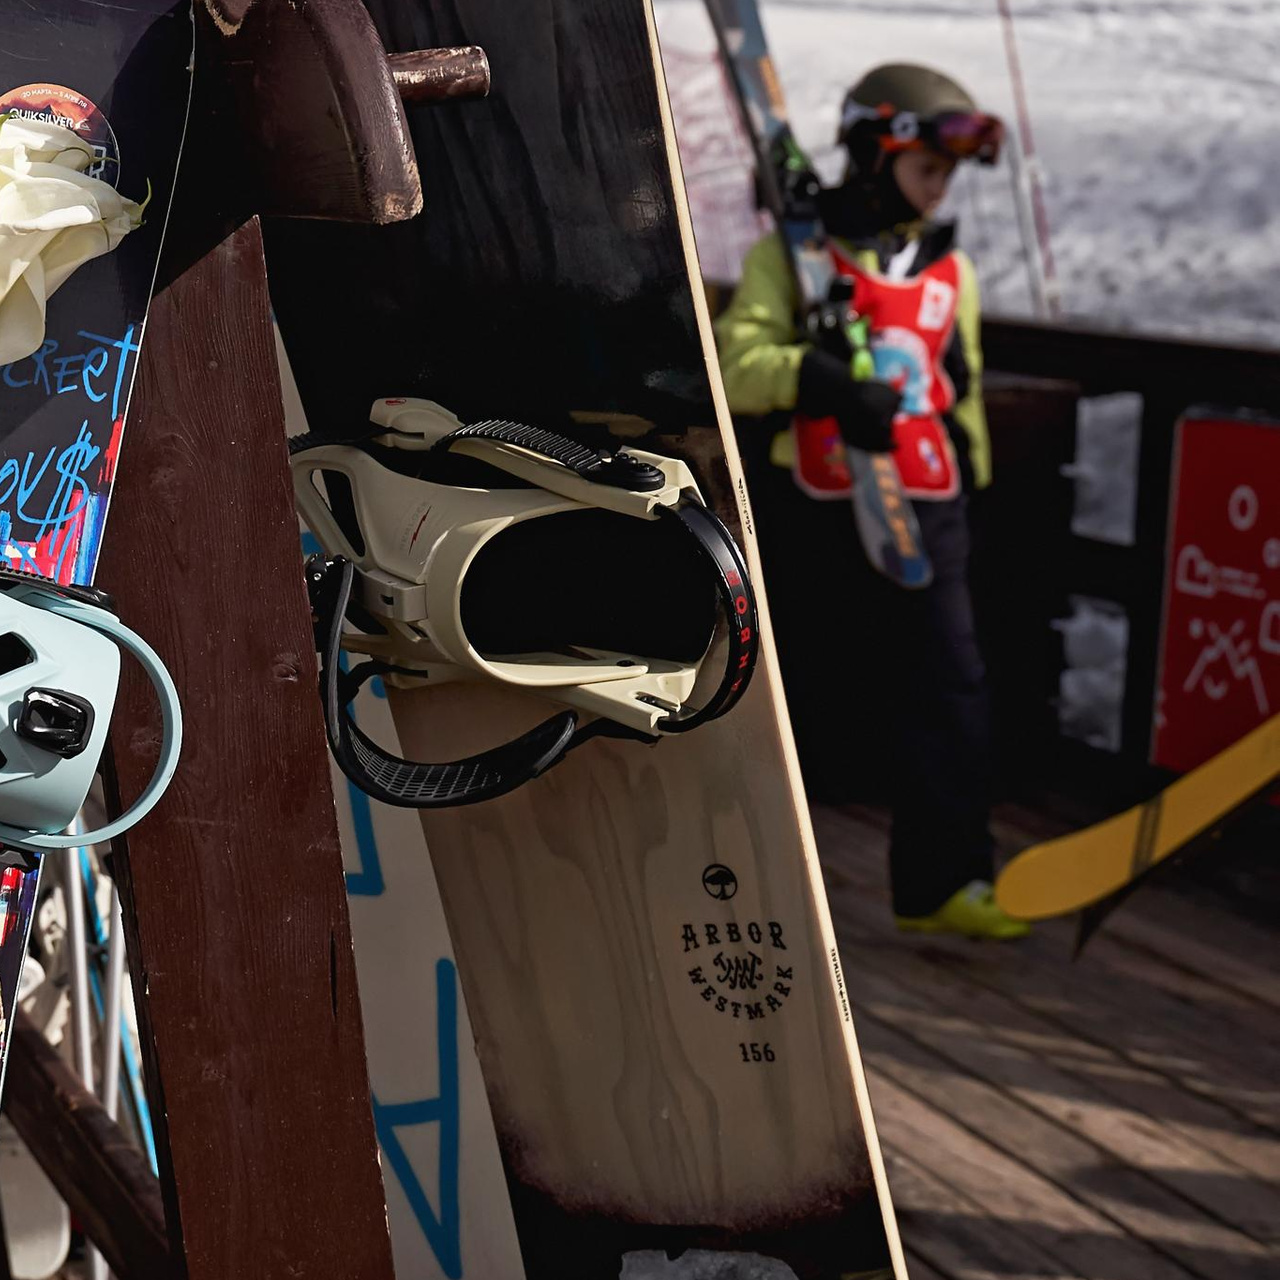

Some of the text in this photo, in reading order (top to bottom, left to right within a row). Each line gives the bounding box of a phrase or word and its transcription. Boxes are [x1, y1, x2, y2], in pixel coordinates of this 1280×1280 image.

[31, 88, 52, 96] МАРТА
[64, 92, 88, 109] АПРЕЛЯ
[9, 107, 75, 129] QUIKSILVER
[681, 921, 787, 952] ARBOR
[688, 964, 794, 1021] WESTMARK
[739, 1042, 776, 1062] 156
